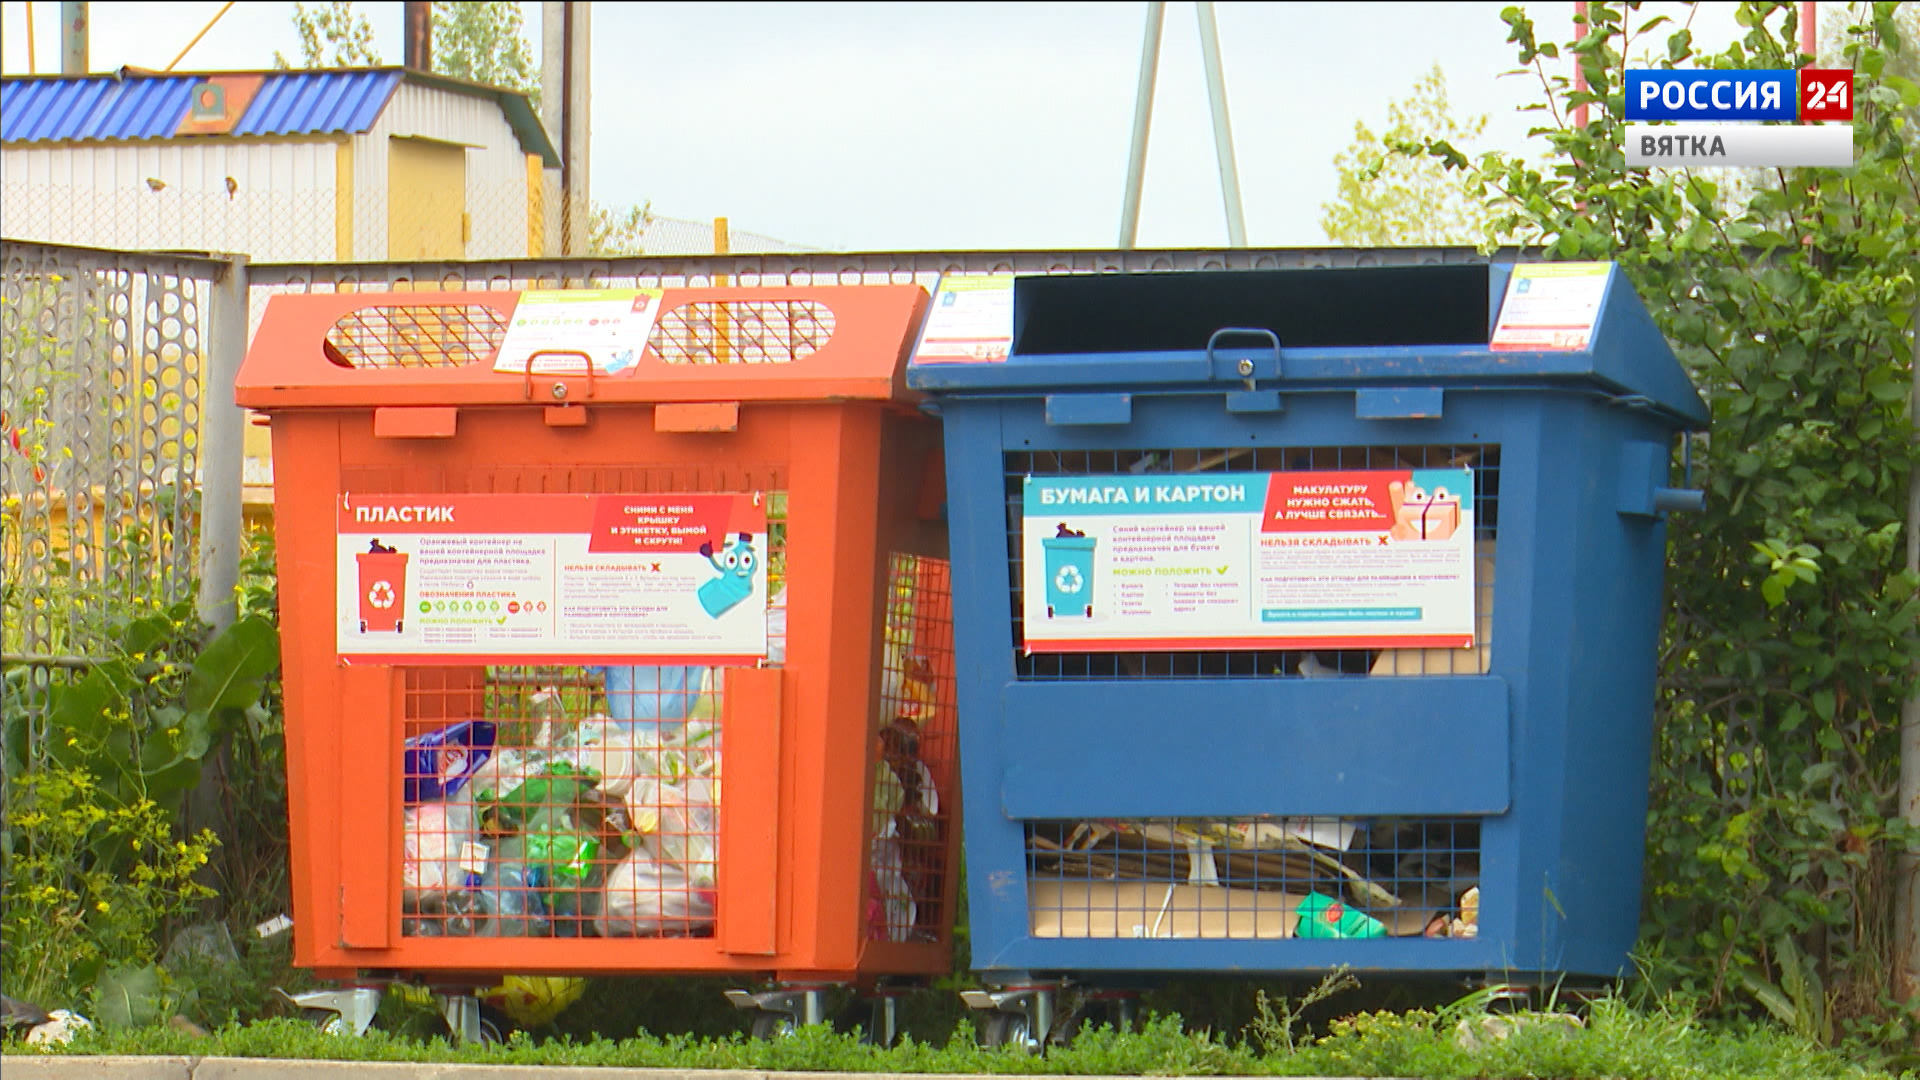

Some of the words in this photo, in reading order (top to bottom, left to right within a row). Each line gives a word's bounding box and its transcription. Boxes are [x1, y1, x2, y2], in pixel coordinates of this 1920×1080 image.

[1041, 486, 1129, 505] БУМАГА
[1134, 485, 1150, 503] И
[1155, 484, 1246, 503] КАРТОН
[1293, 485, 1368, 495] МАКУЛАТУРУ
[1286, 498, 1329, 507] НУЖНО
[355, 506, 455, 523] ПЛАСТИК
[623, 505, 657, 514] СНИМИ
[659, 505, 666, 514] С
[667, 505, 694, 514] МЕНЯ
[1274, 511, 1283, 520] А
[1285, 510, 1327, 520] ЛУЧШЕ
[637, 516, 681, 525] КРЫШКУ
[611, 527, 618, 535] И
[620, 527, 670, 536] ЭТИКЕТКУ,
[671, 524, 707, 535] ВЫМОЙ
[1140, 524, 1185, 534] контейнер
[1198, 524, 1226, 532] вашей
[419, 538, 467, 546] Оранжевый
[469, 538, 512, 546] контейнер
[634, 537, 641, 546] И
[643, 537, 683, 546] СКРУТИ!
[1112, 534, 1172, 544] контейнерной
[1173, 534, 1216, 542] площадке
[1260, 538, 1300, 547] НЕЛЬЗЯ
[1302, 536, 1372, 547] СКЛАДЫВАТЬ
[419, 547, 446, 555] вашей
[447, 547, 504, 557] контейнерной
[505, 548, 546, 557] площадке
[1112, 546, 1172, 554] предназначен
[1173, 544, 1188, 552] для
[1190, 544, 1220, 552] бумаги
[419, 558, 476, 566] предназначен
[477, 558, 492, 566] для
[564, 564, 594, 572] НЕЛЬЗЯ
[595, 564, 647, 572] СКЛАДЫВАТЬ
[1112, 568, 1152, 576] МОЖНО
[1154, 566, 1213, 576] ПОЛОЖИТЬ
